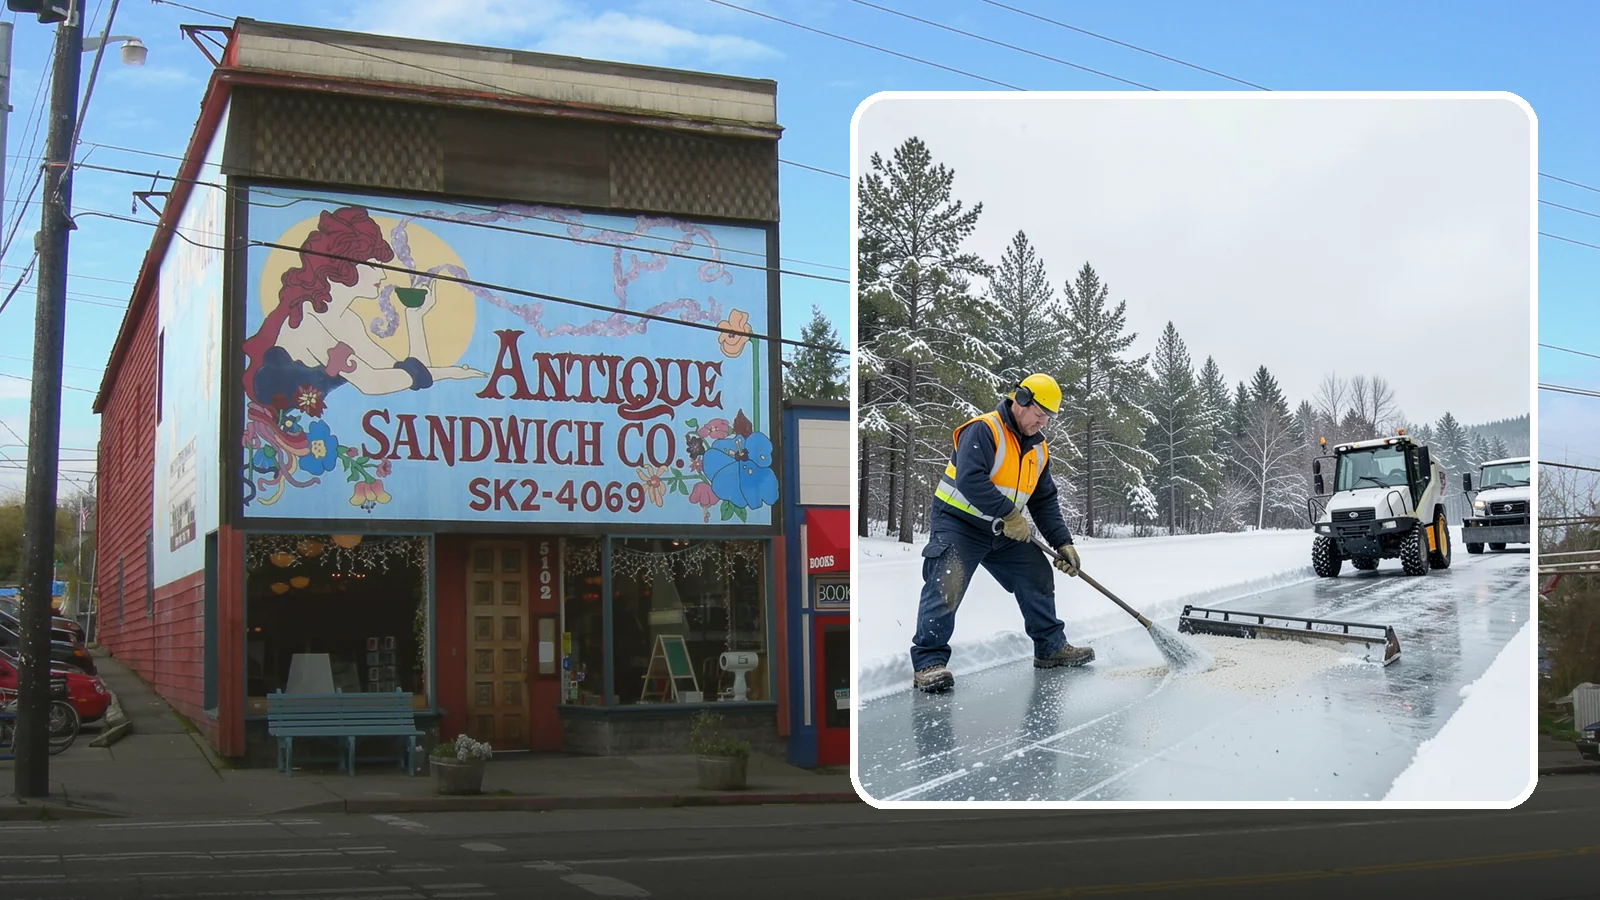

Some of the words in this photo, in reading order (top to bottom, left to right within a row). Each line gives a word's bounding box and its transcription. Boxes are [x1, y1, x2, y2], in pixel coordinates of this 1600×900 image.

[475, 329, 723, 420] ANTIQUE
[361, 408, 605, 467] SANDWICH
[617, 422, 685, 469] CO.
[468, 477, 646, 513] SK2-4069
[540, 542, 551, 599] 5102
[809, 555, 835, 569] BOOKS
